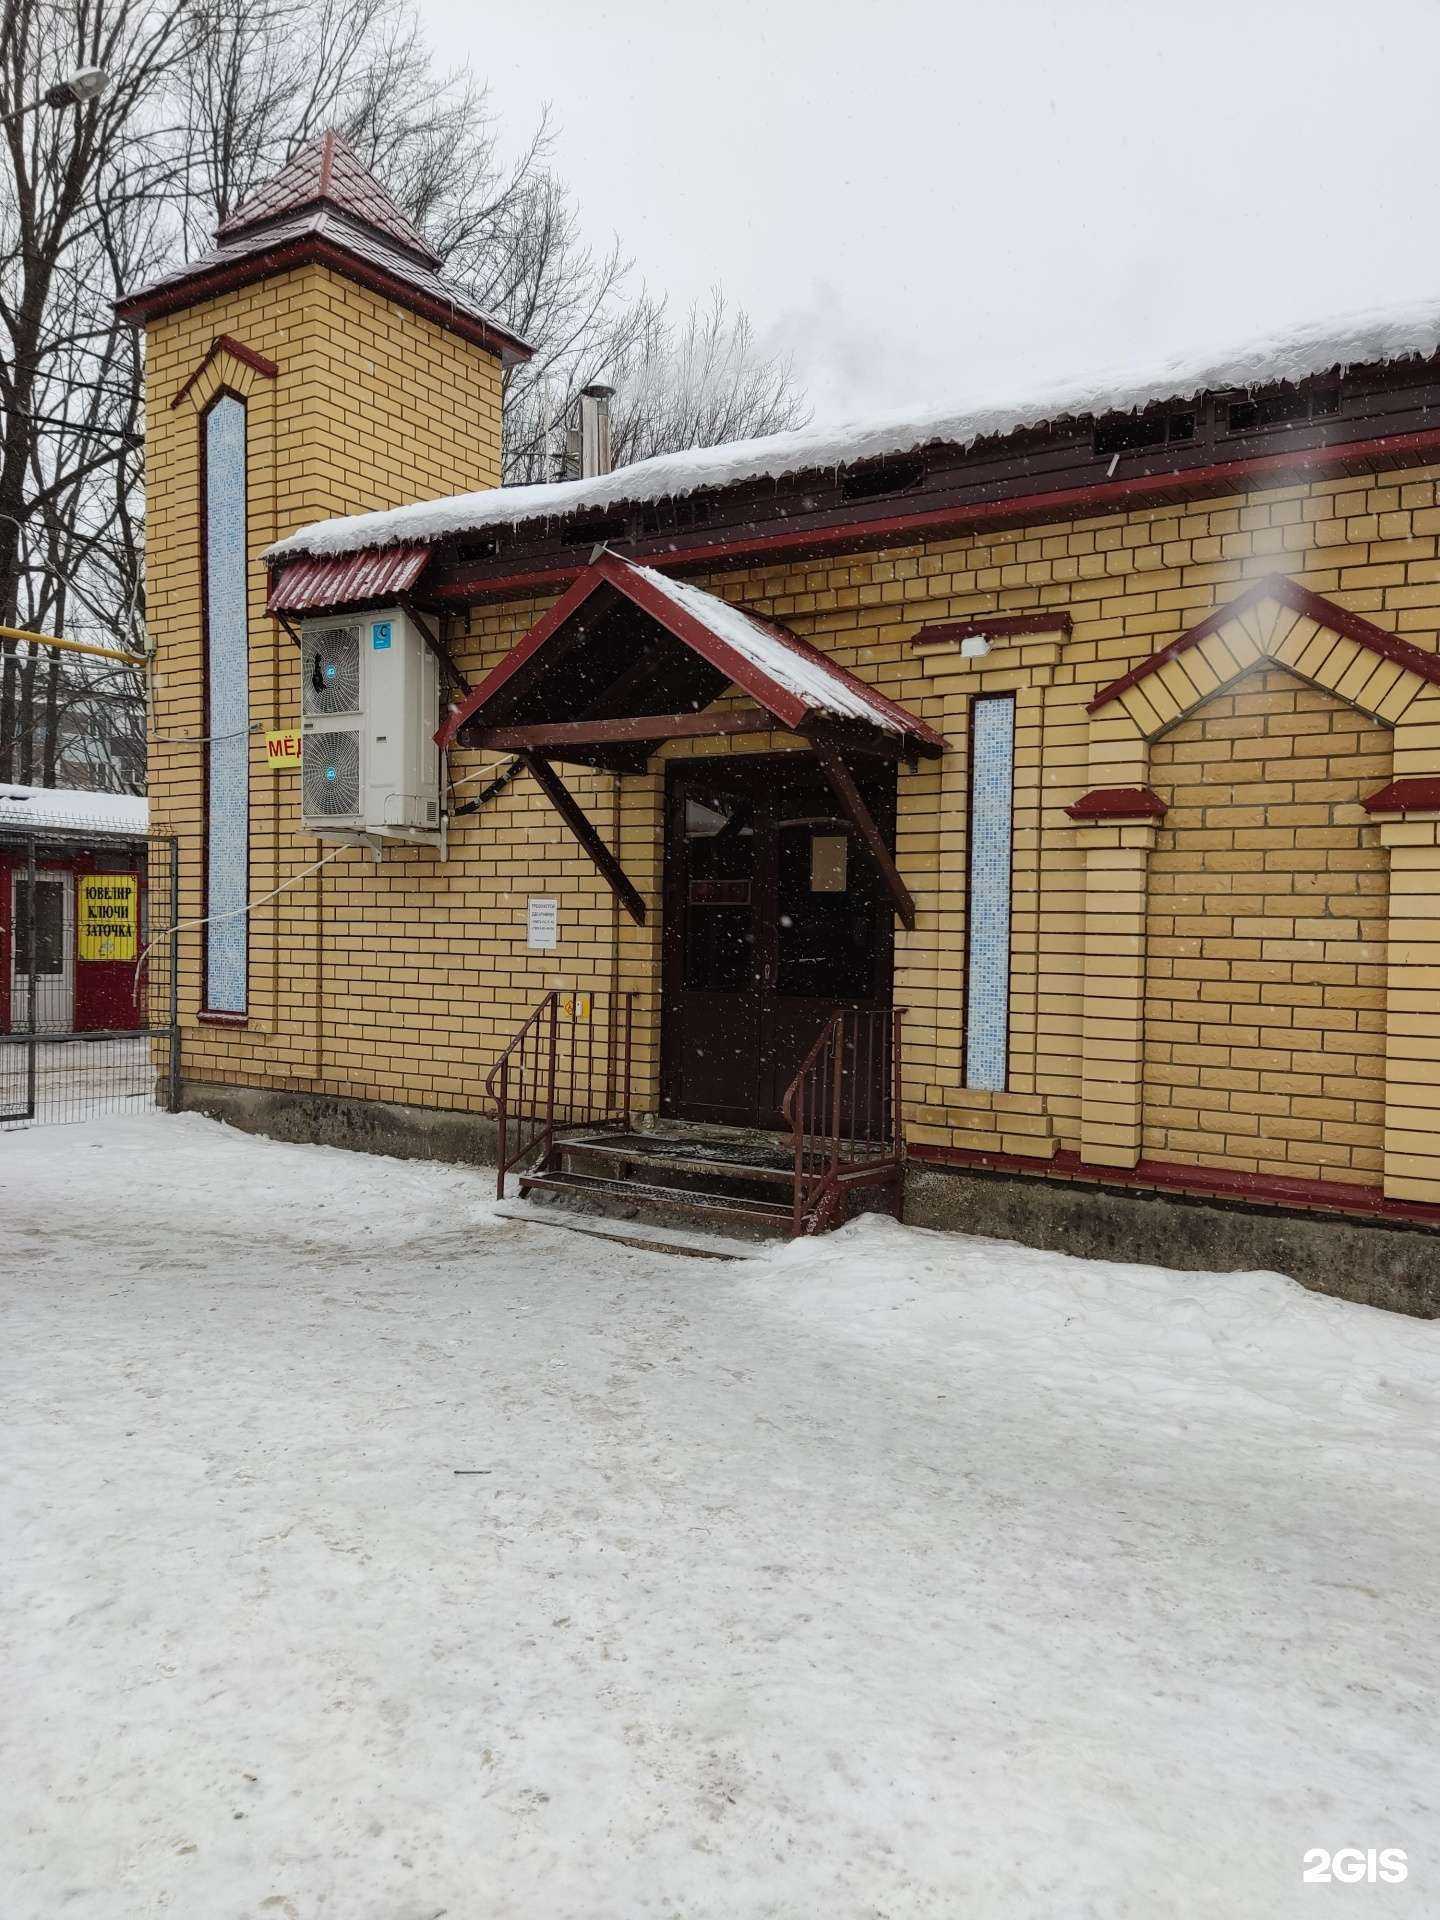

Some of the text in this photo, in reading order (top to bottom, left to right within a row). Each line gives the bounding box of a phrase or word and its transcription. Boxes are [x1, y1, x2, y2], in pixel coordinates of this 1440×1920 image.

[86, 886, 132, 900] ЮВЕЛИР
[88, 905, 129, 918] КЛЮЧИ
[86, 924, 132, 937] ЗАТОЧКА
